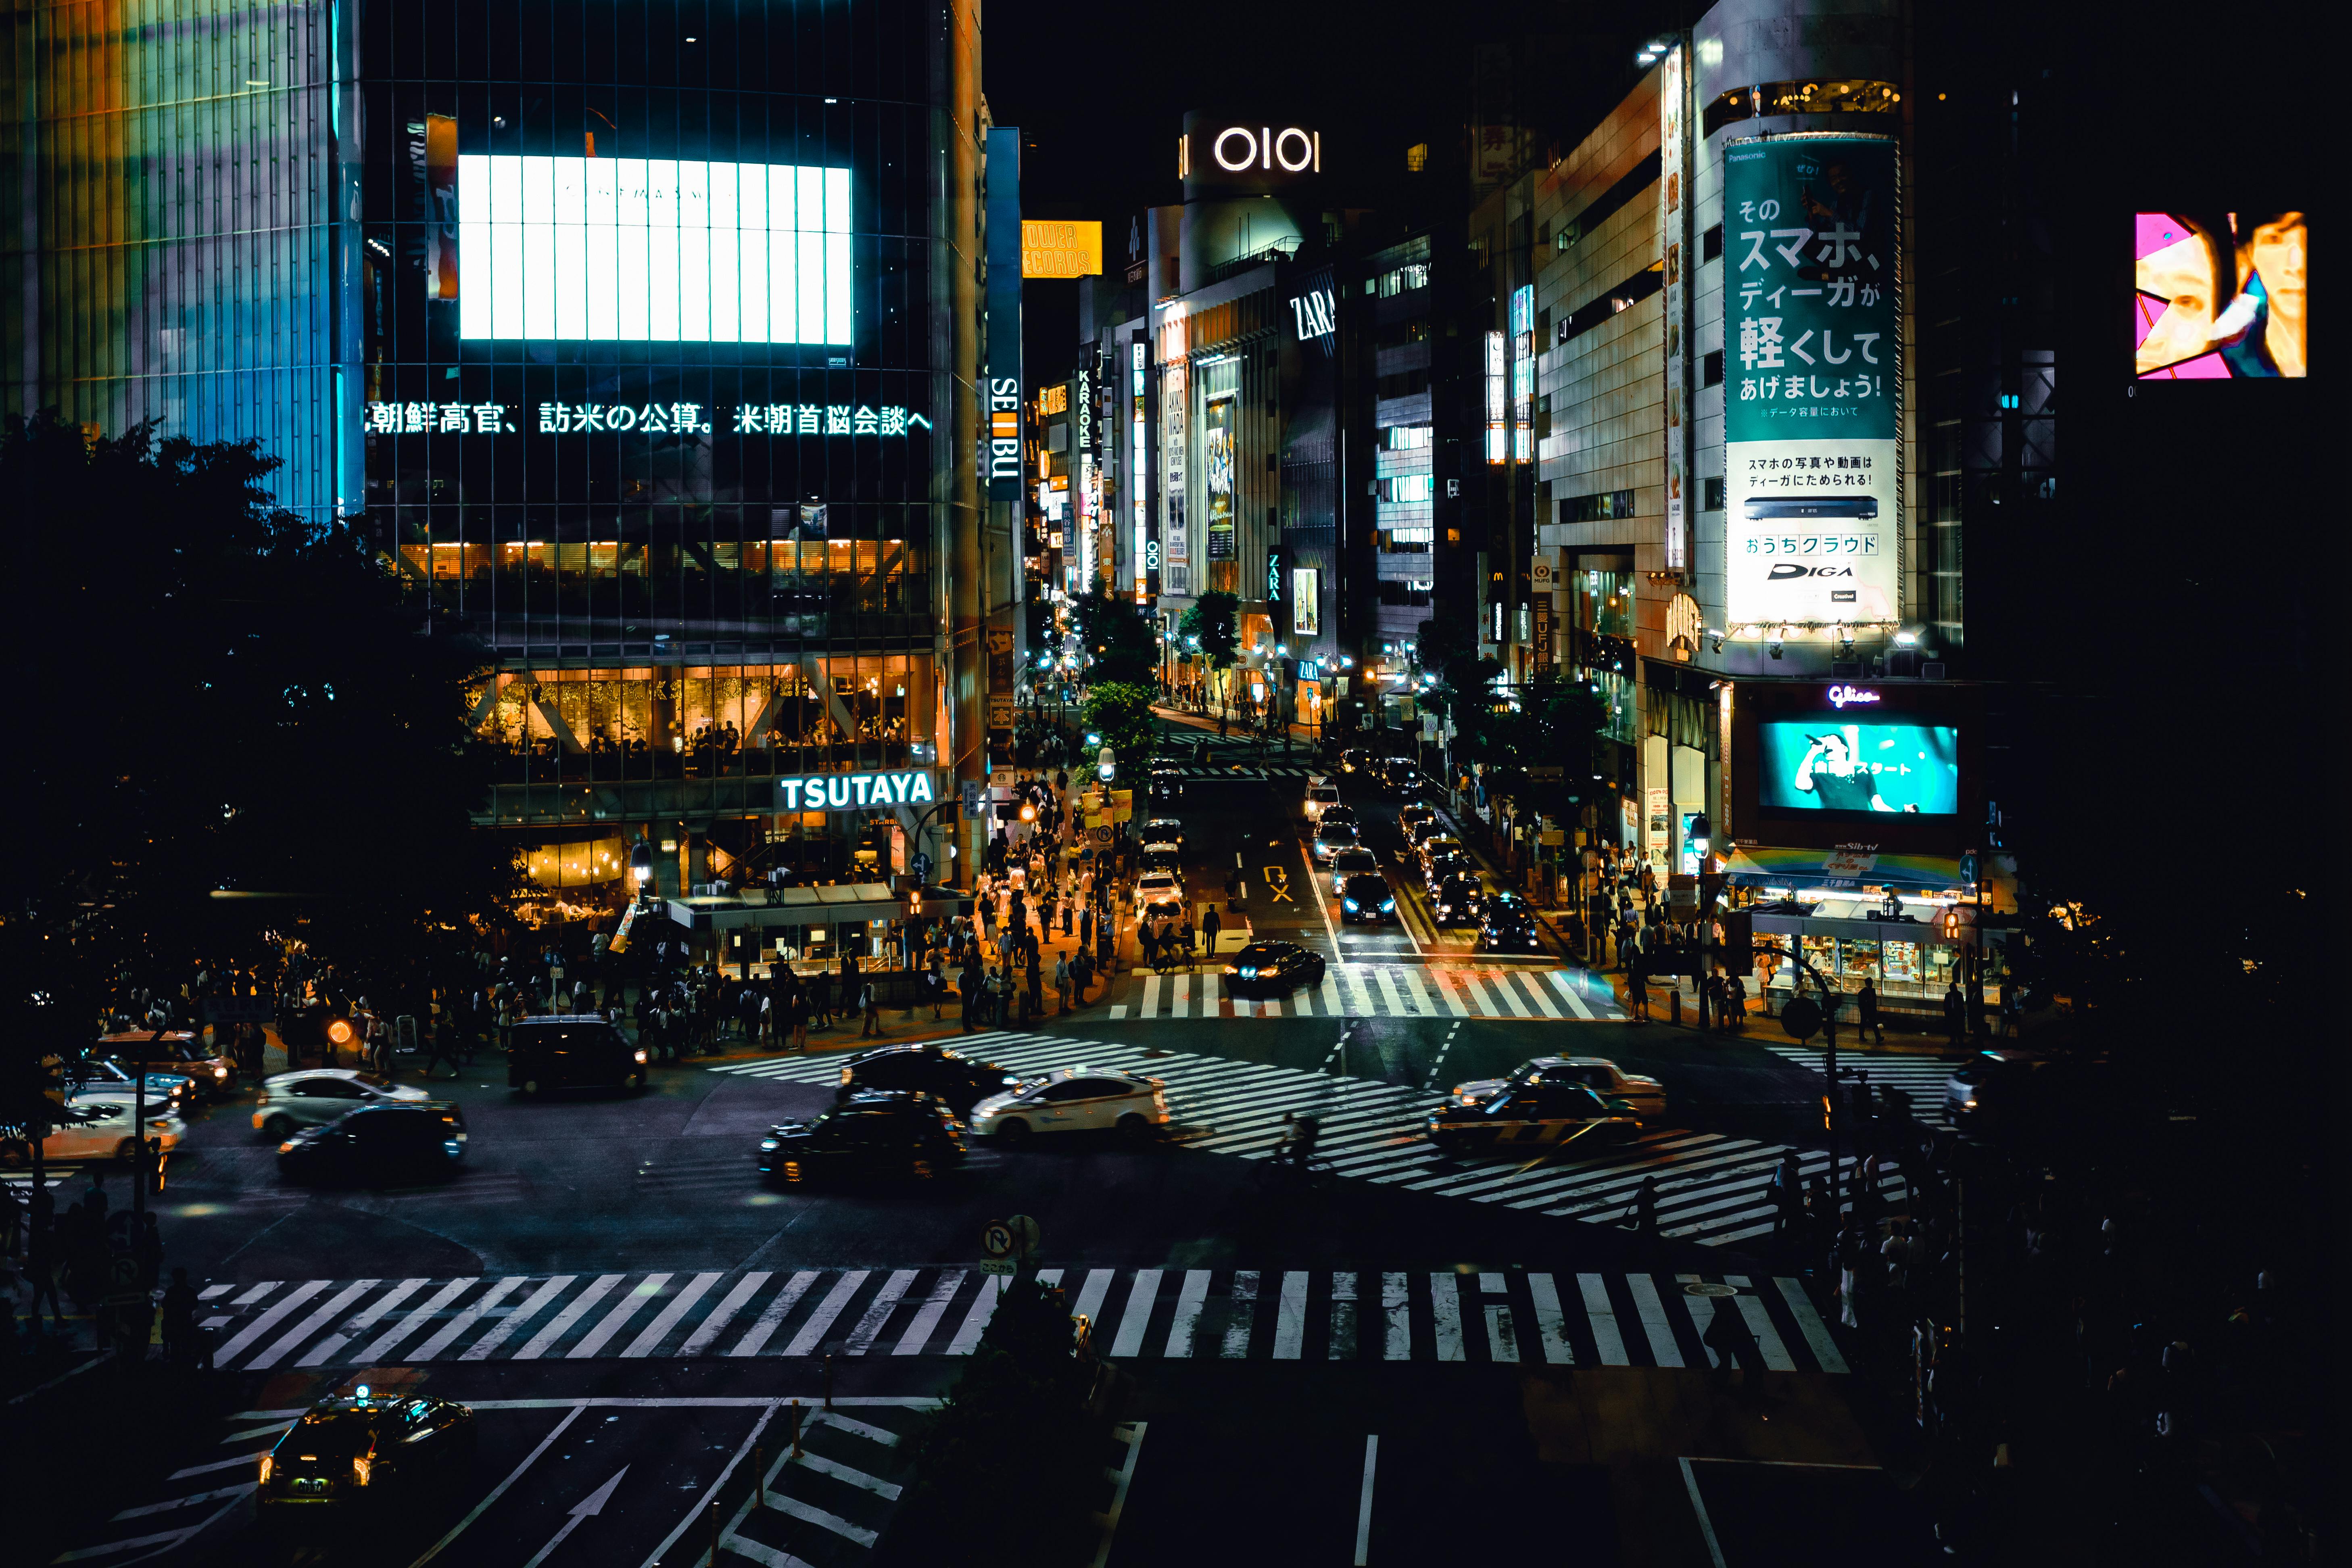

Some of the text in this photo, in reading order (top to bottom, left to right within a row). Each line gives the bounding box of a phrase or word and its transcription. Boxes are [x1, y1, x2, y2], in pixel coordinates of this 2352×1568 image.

[1729, 151, 1766, 162] Panasonic
[1739, 199, 1779, 223] その
[1739, 222, 1880, 272] スマホ、
[1740, 275, 1880, 311] ディーガが
[1740, 316, 1880, 370] 軽くして
[1740, 374, 1881, 401] あげましょう!
[1079, 370, 1091, 447] KARAOKE
[1169, 390, 1183, 413] AKIKO
[733, 403, 931, 435] 米朝首脳会談へ
[1168, 412, 1184, 436] WADA
[1749, 456, 1872, 470] スマホの写真や動画は
[1750, 474, 1872, 487] ディーガにためられる!
[1747, 537, 1876, 553] おうちクラウド
[1268, 554, 1280, 601] ZARA
[1768, 564, 1853, 580] DIGA
[1300, 661, 1319, 681] ZARA
[994, 708, 1009, 724] 本
[781, 773, 931, 808] TSUTAYA
[983, 1263, 1014, 1274] ここから
